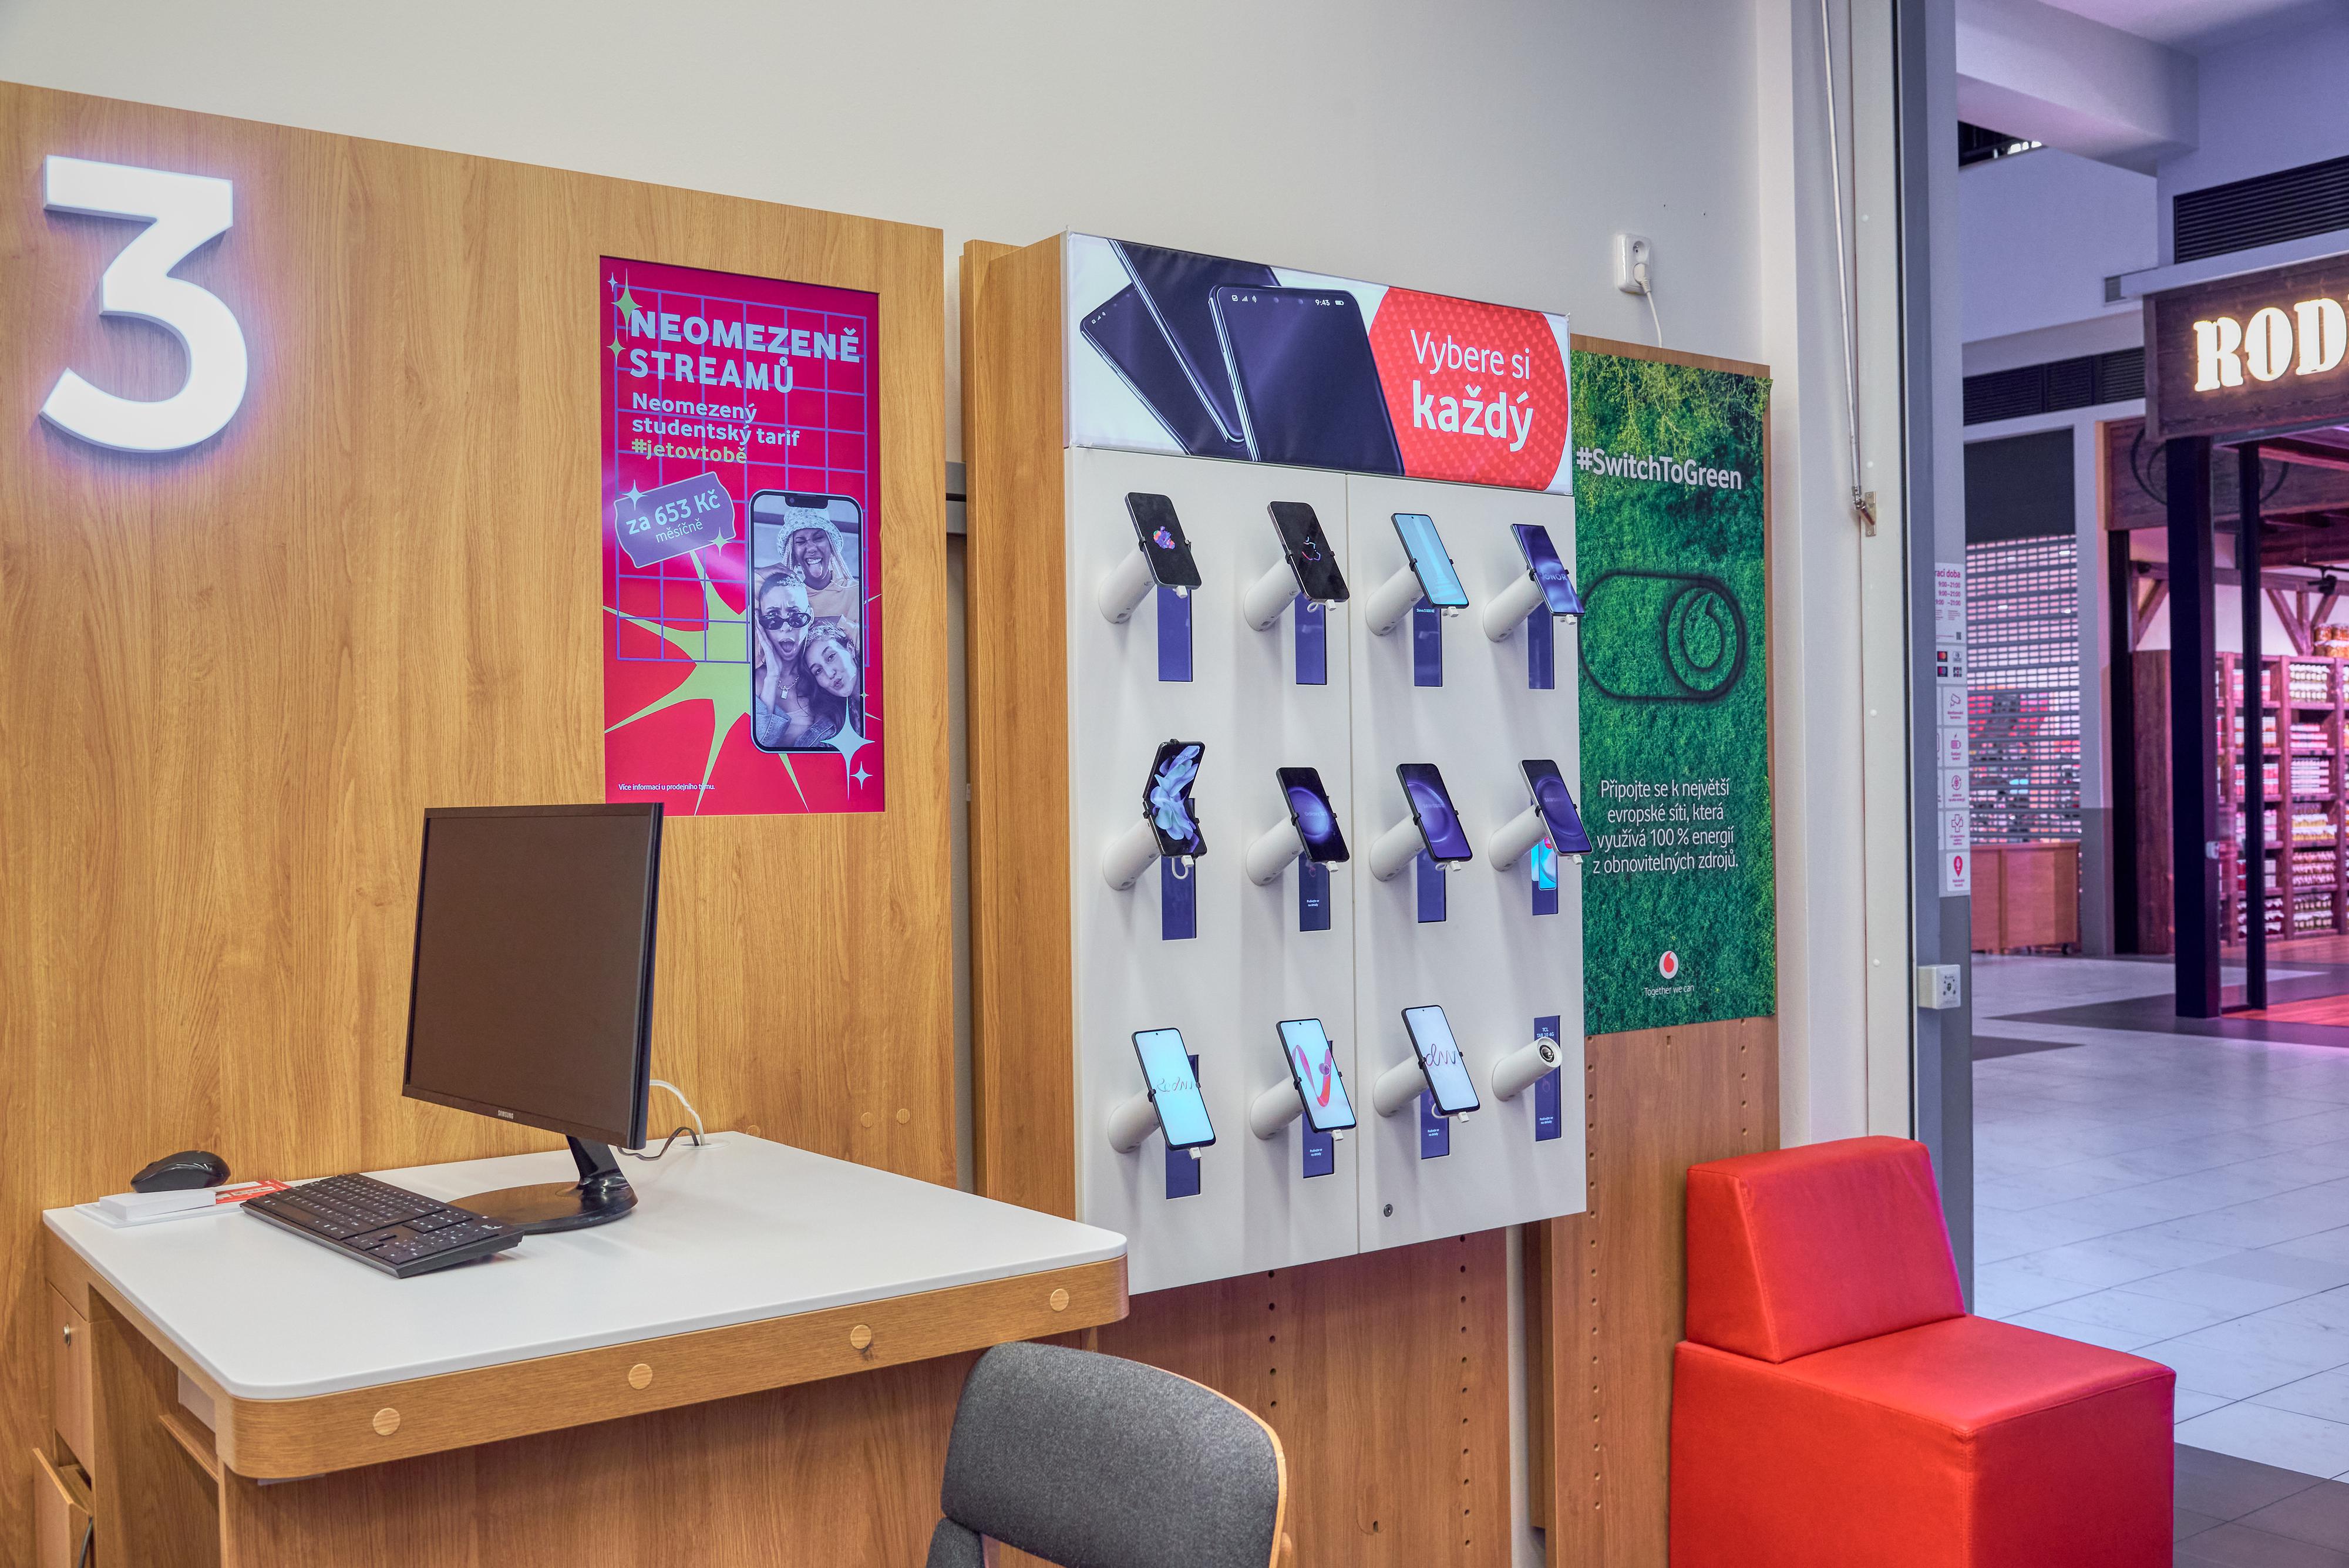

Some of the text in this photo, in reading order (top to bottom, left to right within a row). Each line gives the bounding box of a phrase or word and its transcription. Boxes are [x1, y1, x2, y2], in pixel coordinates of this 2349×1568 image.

[39, 154, 248, 453] 3
[631, 309, 860, 363] NEOMEZENĚ
[2193, 294, 2349, 392] ROD
[1410, 329, 1530, 380] Vybere si
[630, 349, 793, 393] STREAMŮ
[633, 392, 757, 423] Neomezený
[1412, 380, 1534, 452] každý
[632, 419, 800, 446] studentský tarif
[631, 439, 748, 465] #jetovtobě
[1576, 446, 1742, 490] #SwitchToGreen
[626, 489, 721, 535] za 653 Kč
[655, 520, 704, 543] měsíčně
[1946, 570, 1960, 578] doba
[1601, 778, 1730, 802] Připojte se k největší
[1607, 802, 1724, 826] evropské síti, která
[1597, 826, 1734, 852] využívá 100 % energií
[1593, 849, 1738, 874] z obnovitelných zdrojů.
[1644, 985, 1671, 997] Together
[1684, 984, 1694, 993] can
[498, 1109, 513, 1119] SAMSUNG
